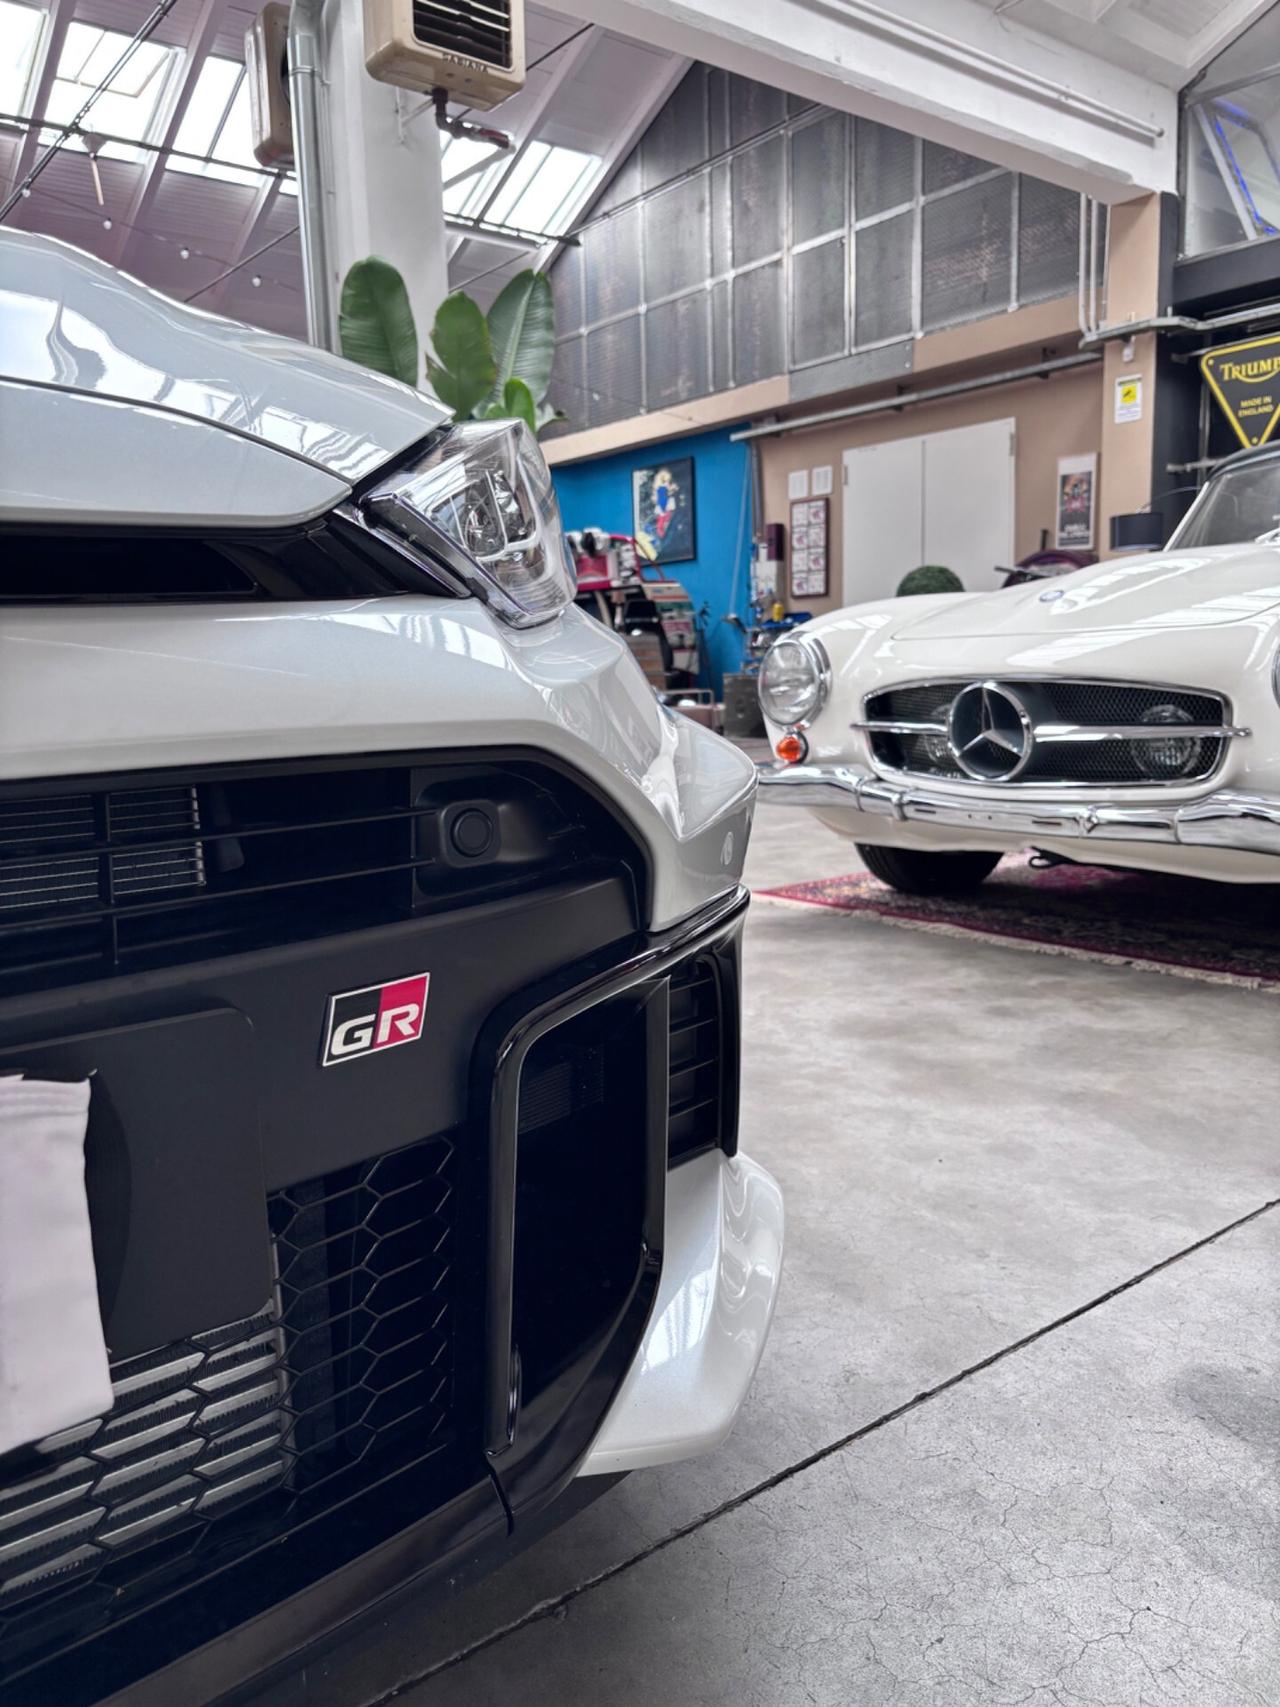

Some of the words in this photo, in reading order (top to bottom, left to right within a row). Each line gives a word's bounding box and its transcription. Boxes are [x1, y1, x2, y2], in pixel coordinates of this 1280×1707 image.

[1240, 397, 1262, 407] MADE
[1262, 396, 1272, 404] IN
[1238, 405, 1274, 417] ENGLAND
[331, 1003, 420, 1055] GR
